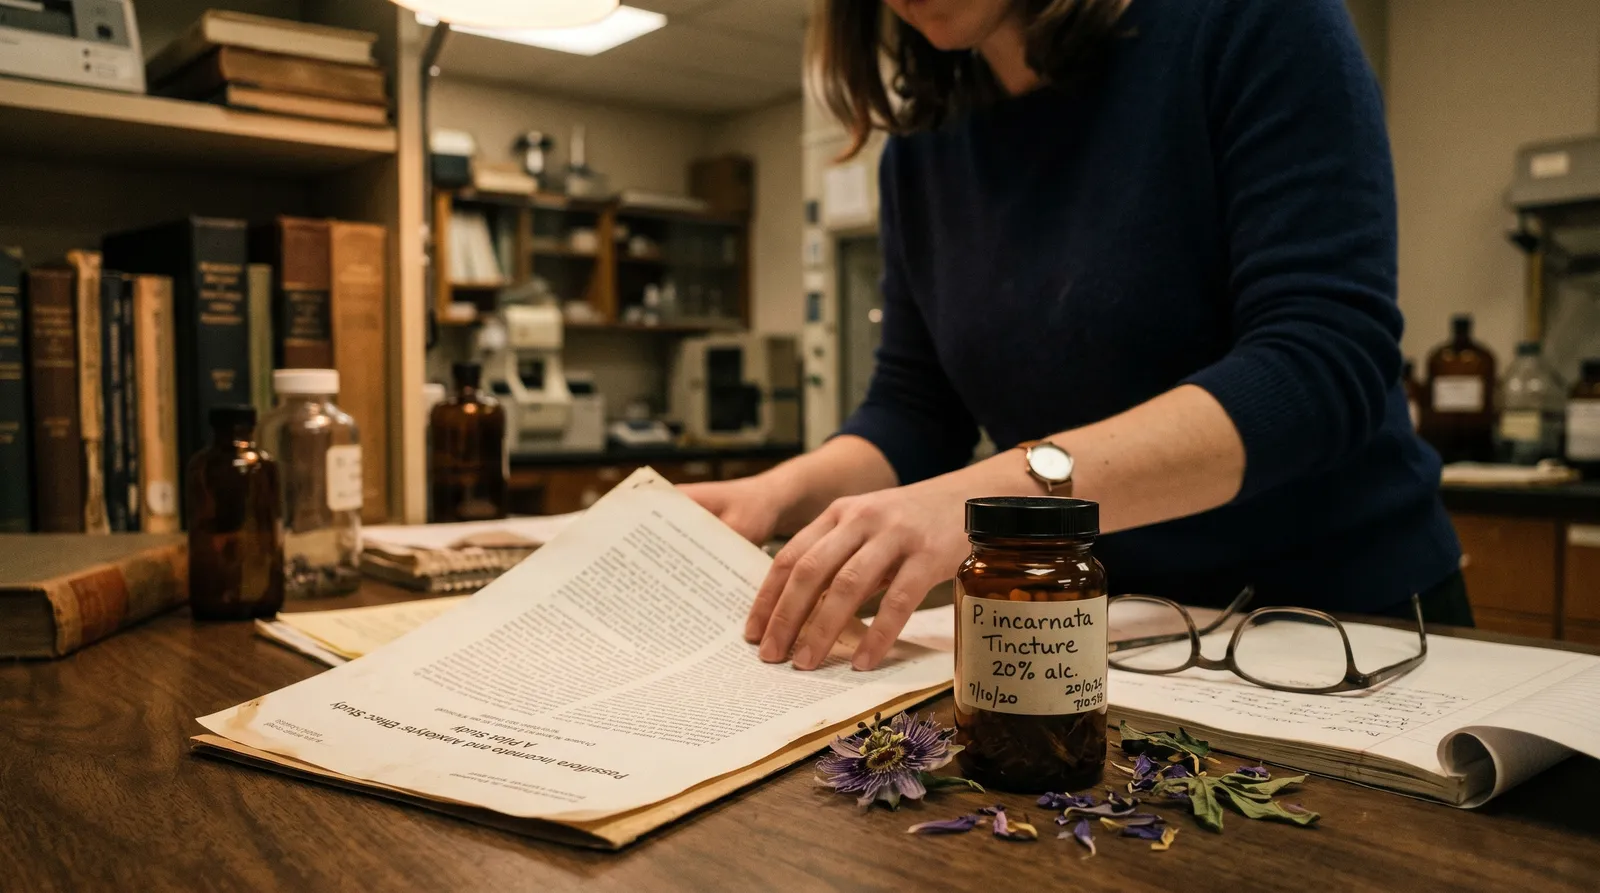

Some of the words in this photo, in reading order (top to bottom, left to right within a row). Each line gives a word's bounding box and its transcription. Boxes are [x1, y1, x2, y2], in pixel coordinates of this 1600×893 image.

[973, 604, 984, 625] P.
[993, 607, 1094, 630] incarnata
[982, 634, 1079, 655] Tincture
[991, 660, 1035, 680] 20%
[1045, 663, 1078, 680] alc.
[969, 682, 1018, 708] 7/10/20
[329, 701, 367, 718] Study
[449, 726, 490, 740] Study
[487, 734, 525, 747] Pilot
[462, 741, 492, 751] and
